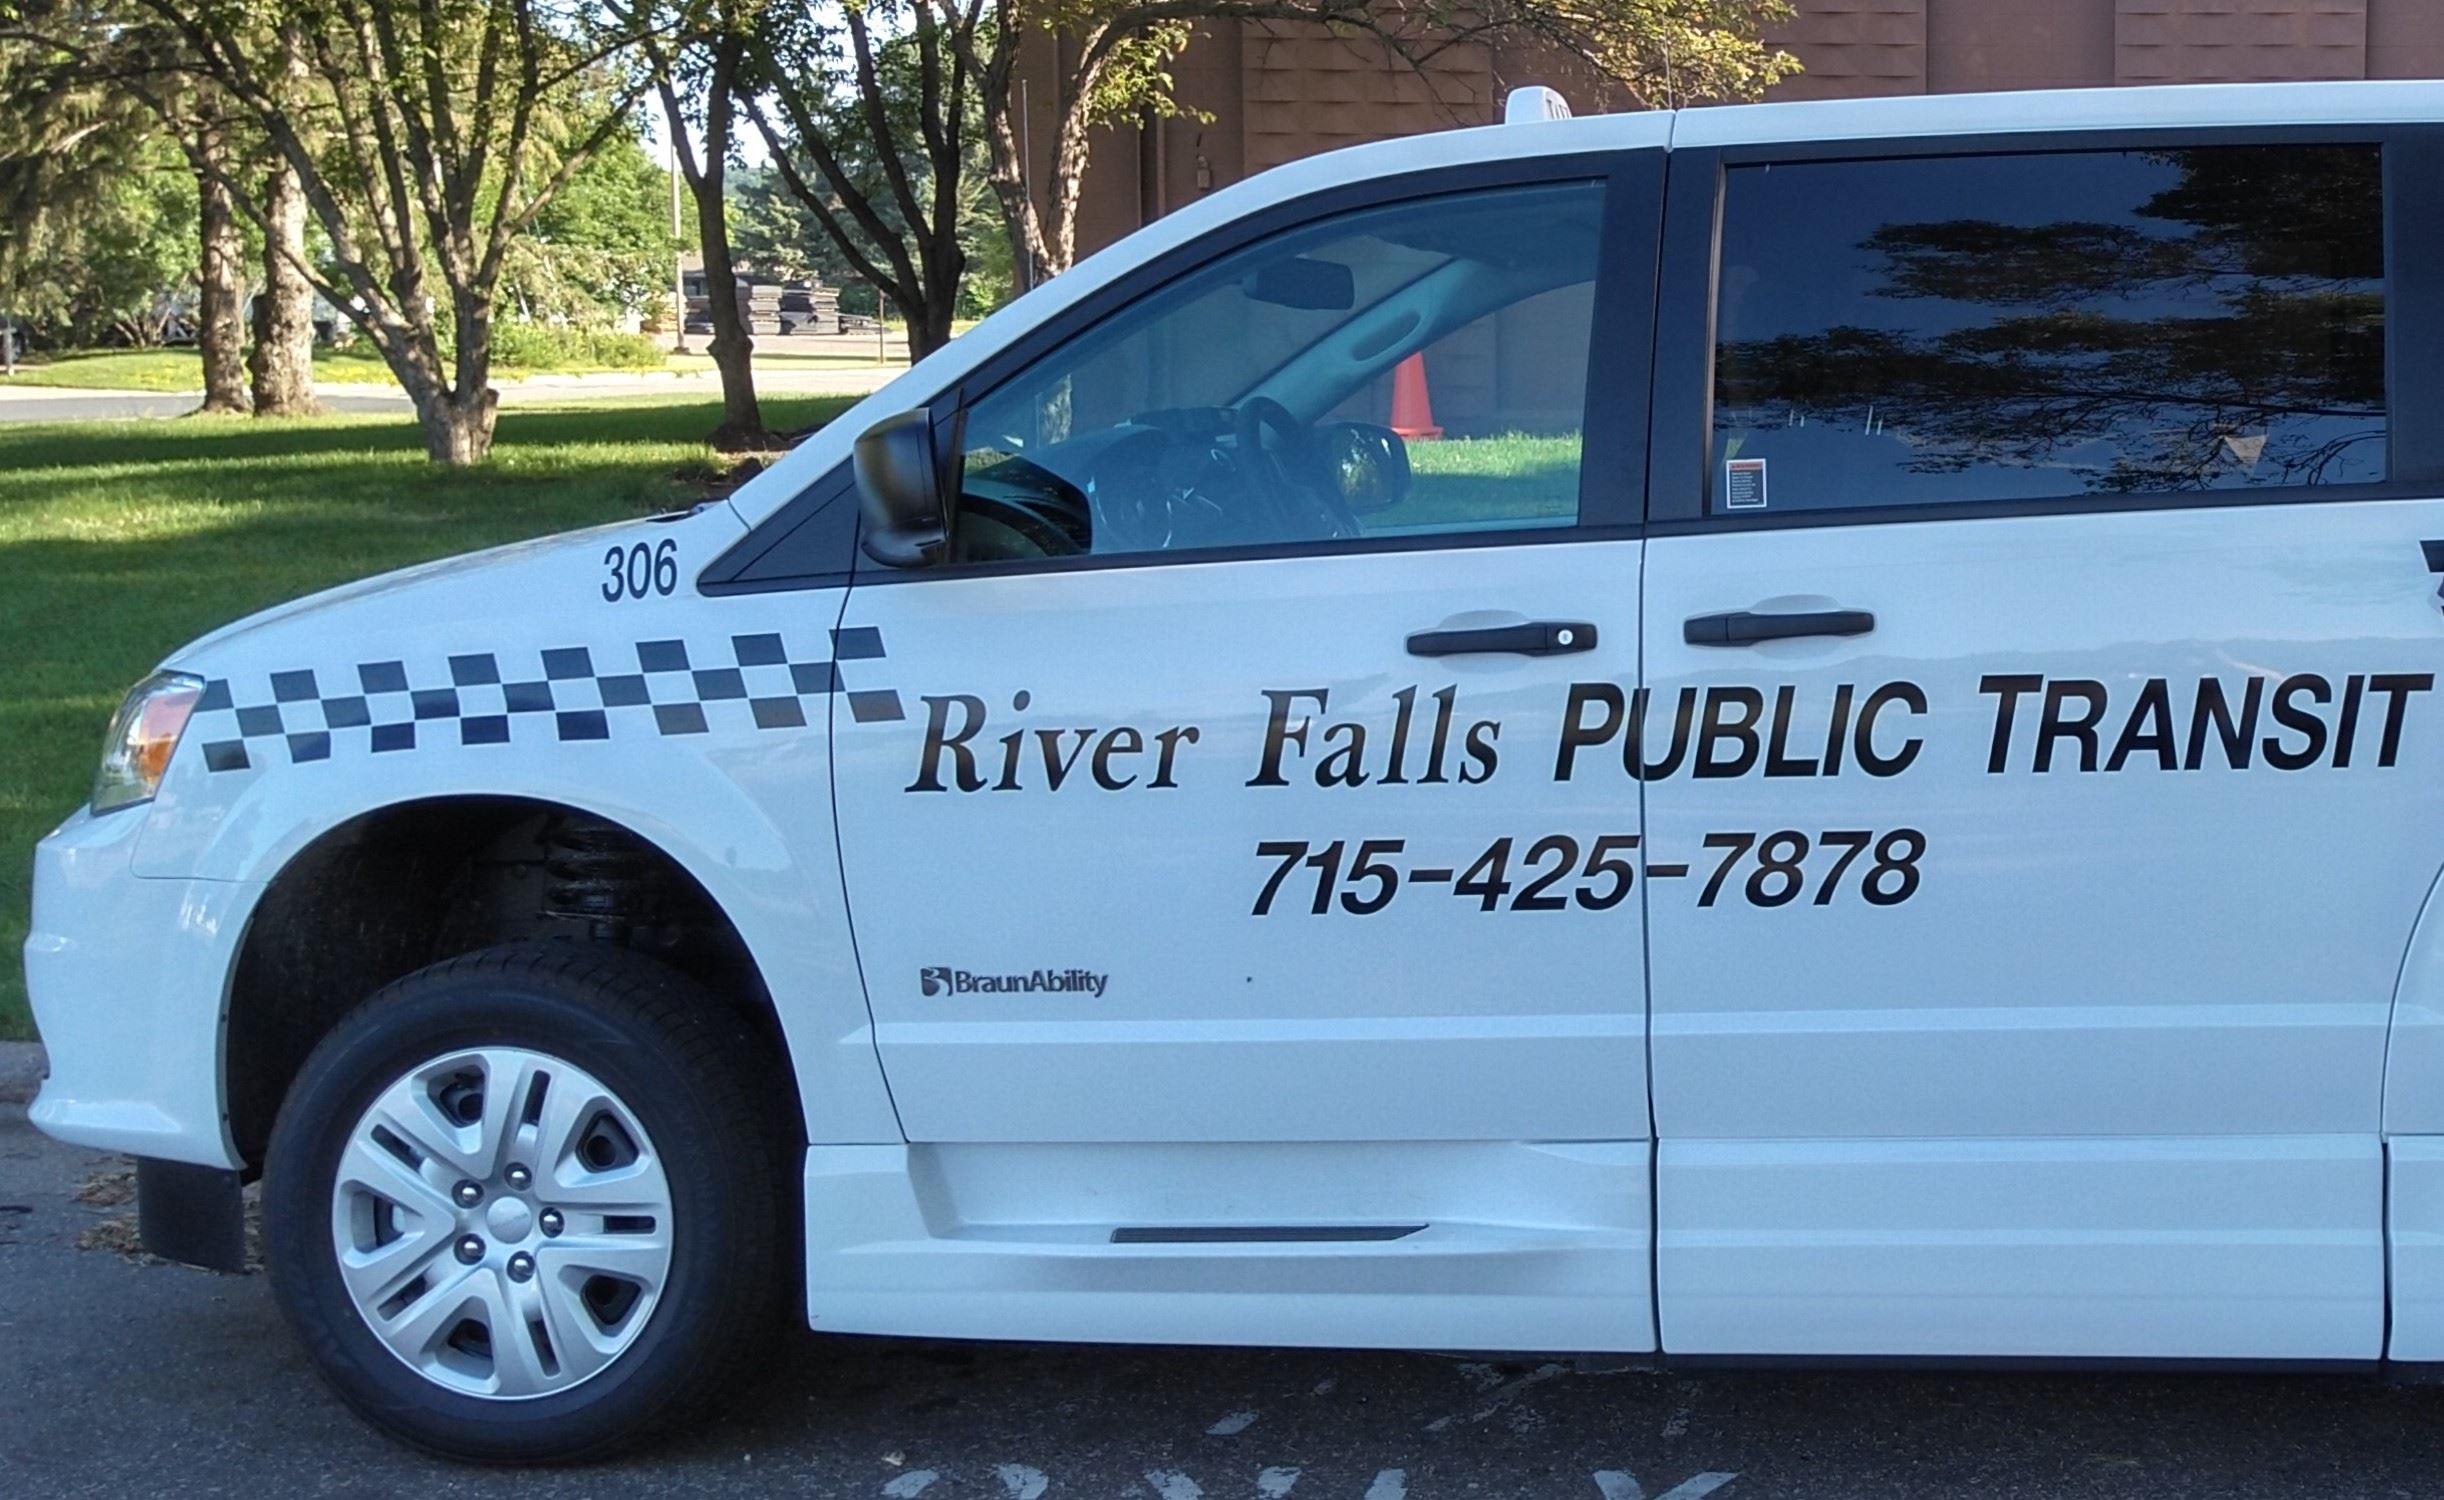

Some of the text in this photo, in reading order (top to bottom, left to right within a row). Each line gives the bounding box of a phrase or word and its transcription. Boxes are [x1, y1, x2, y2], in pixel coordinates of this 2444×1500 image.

[602, 538, 677, 602] 306
[905, 674, 2435, 793] River Falls PUBLIC TRANSIT
[1252, 828, 1926, 916] 715-425-7878
[954, 969, 1108, 998] BraunAbility
